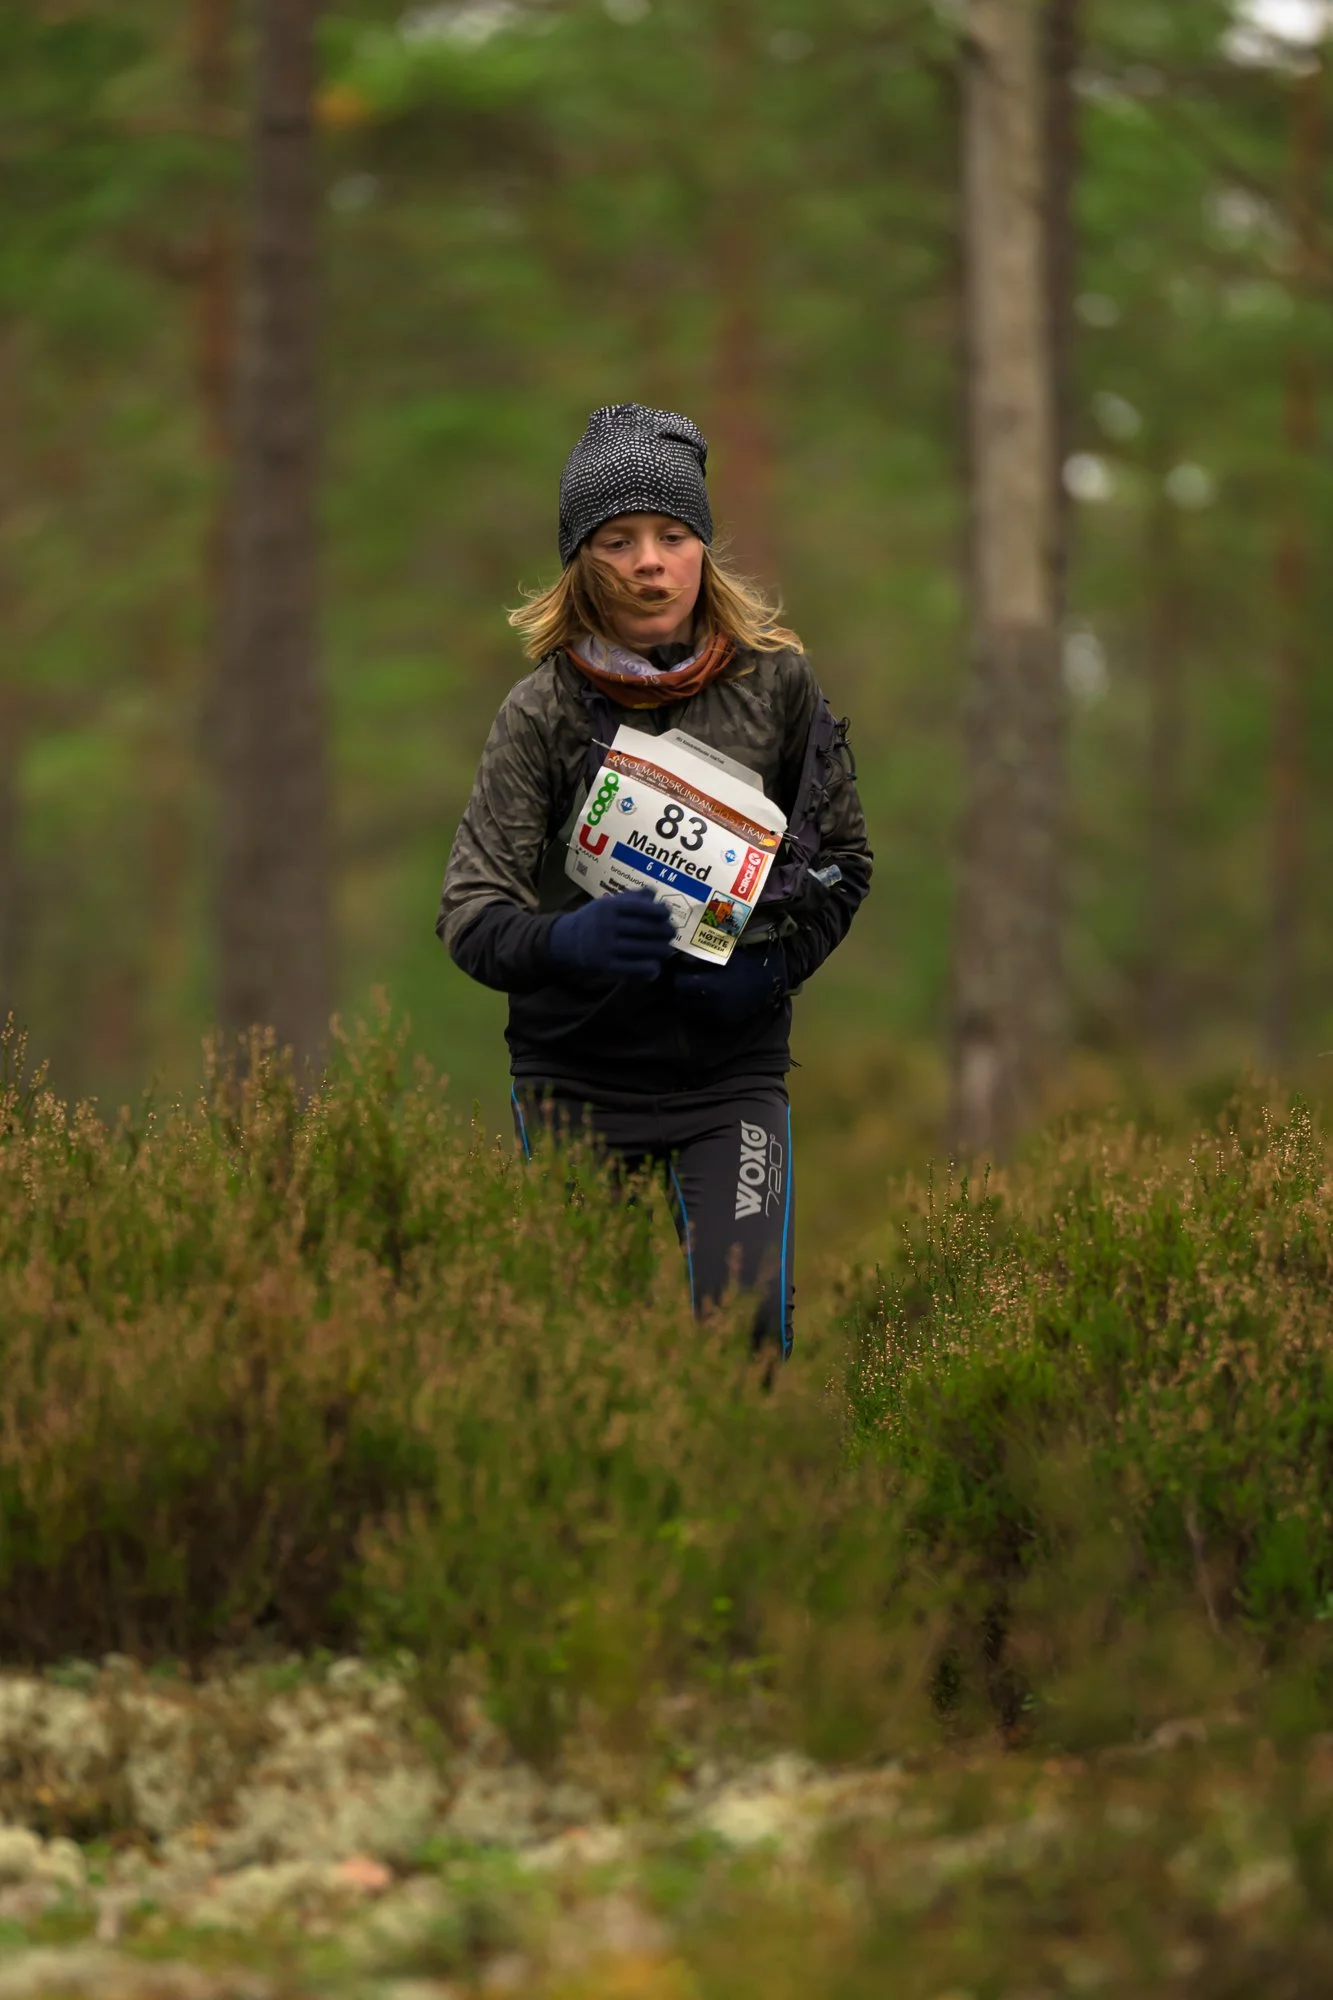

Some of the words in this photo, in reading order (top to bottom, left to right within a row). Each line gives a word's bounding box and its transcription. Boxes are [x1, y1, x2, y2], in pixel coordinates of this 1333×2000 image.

[587, 772, 620, 826] coop
[655, 803, 708, 851] 83
[627, 830, 712, 882] Manfred
[646, 861, 654, 871] 6
[659, 868, 678, 882] KM
[738, 864, 756, 895] CIRCLE
[749, 852, 761, 865] K
[699, 931, 730, 948] NØTTE
